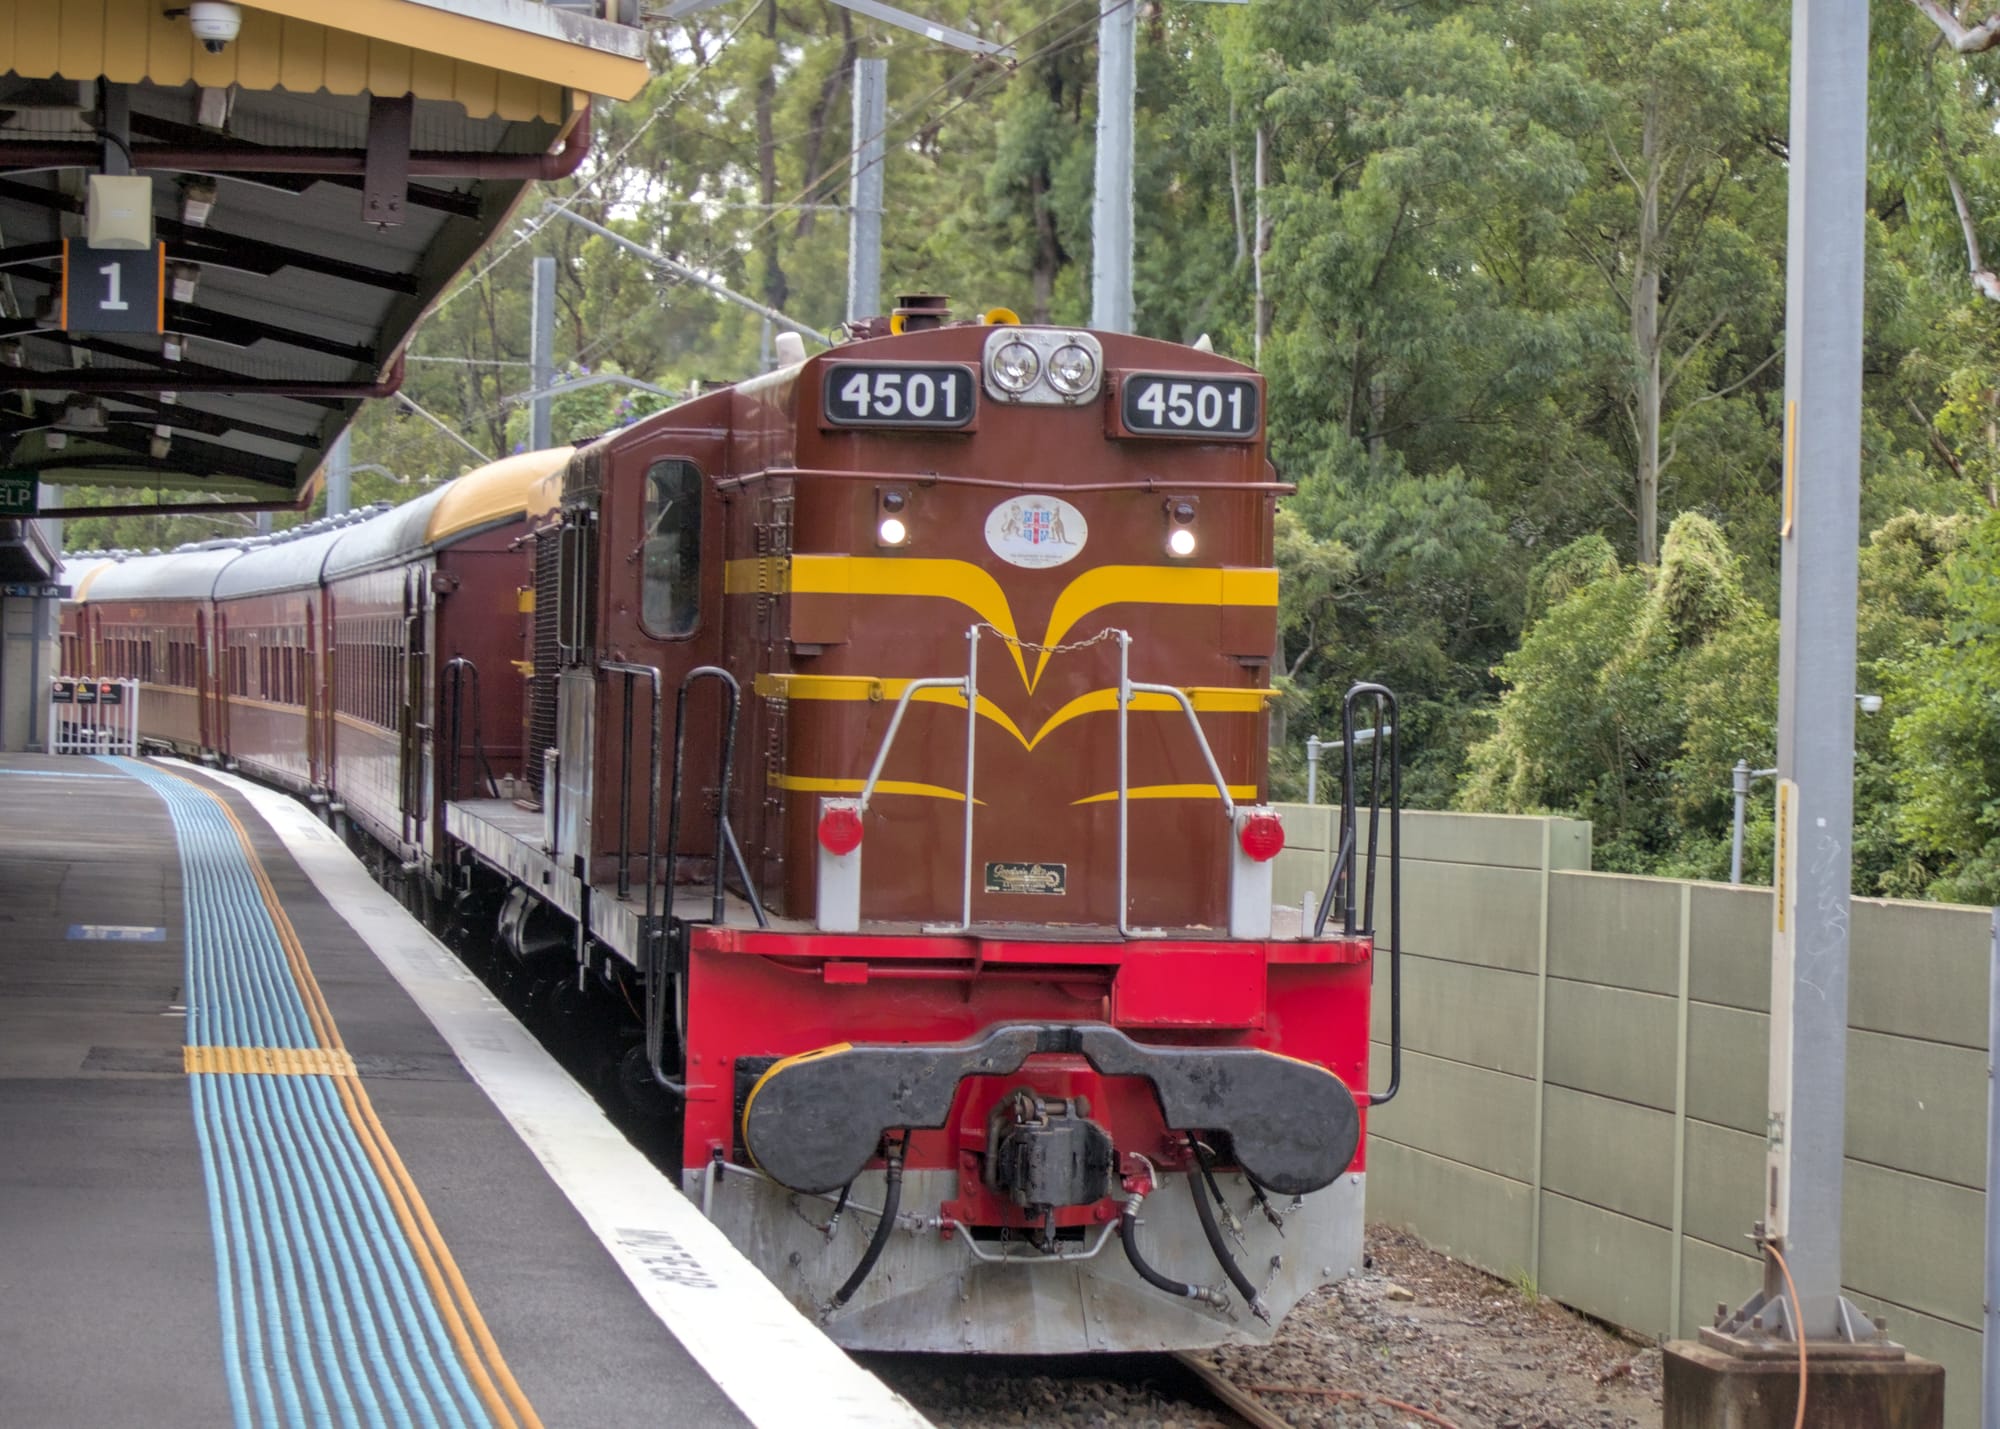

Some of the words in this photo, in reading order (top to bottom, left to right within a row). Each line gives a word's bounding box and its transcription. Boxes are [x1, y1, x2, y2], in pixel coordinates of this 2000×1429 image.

[99, 262, 129, 310] 1
[841, 373, 956, 417] 4501
[1138, 383, 1242, 430] 4501
